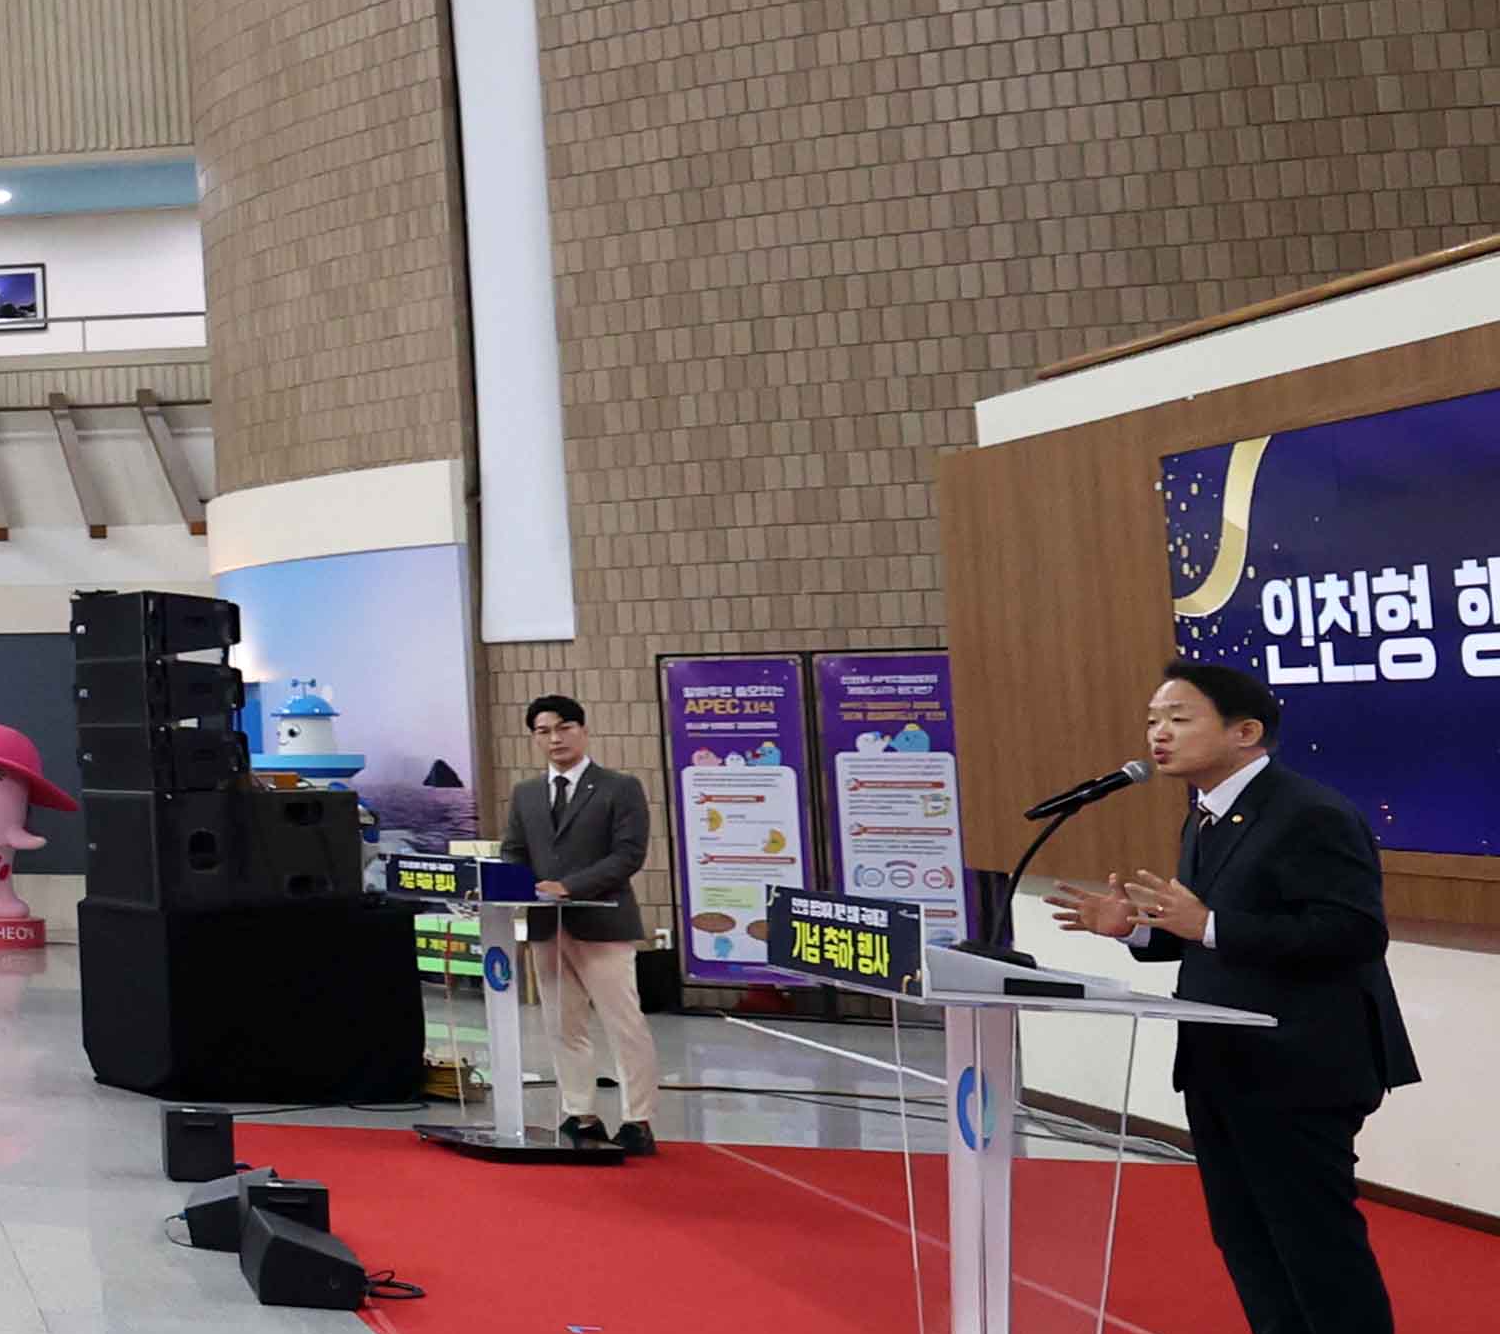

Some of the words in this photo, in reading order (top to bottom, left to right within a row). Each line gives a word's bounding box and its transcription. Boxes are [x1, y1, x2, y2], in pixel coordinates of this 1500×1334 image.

[1260, 563, 1437, 685] 인천형
[684, 698, 740, 715] APEC
[791, 920, 820, 964] 기념
[823, 926, 853, 971] 축하
[857, 931, 889, 978] 행사
